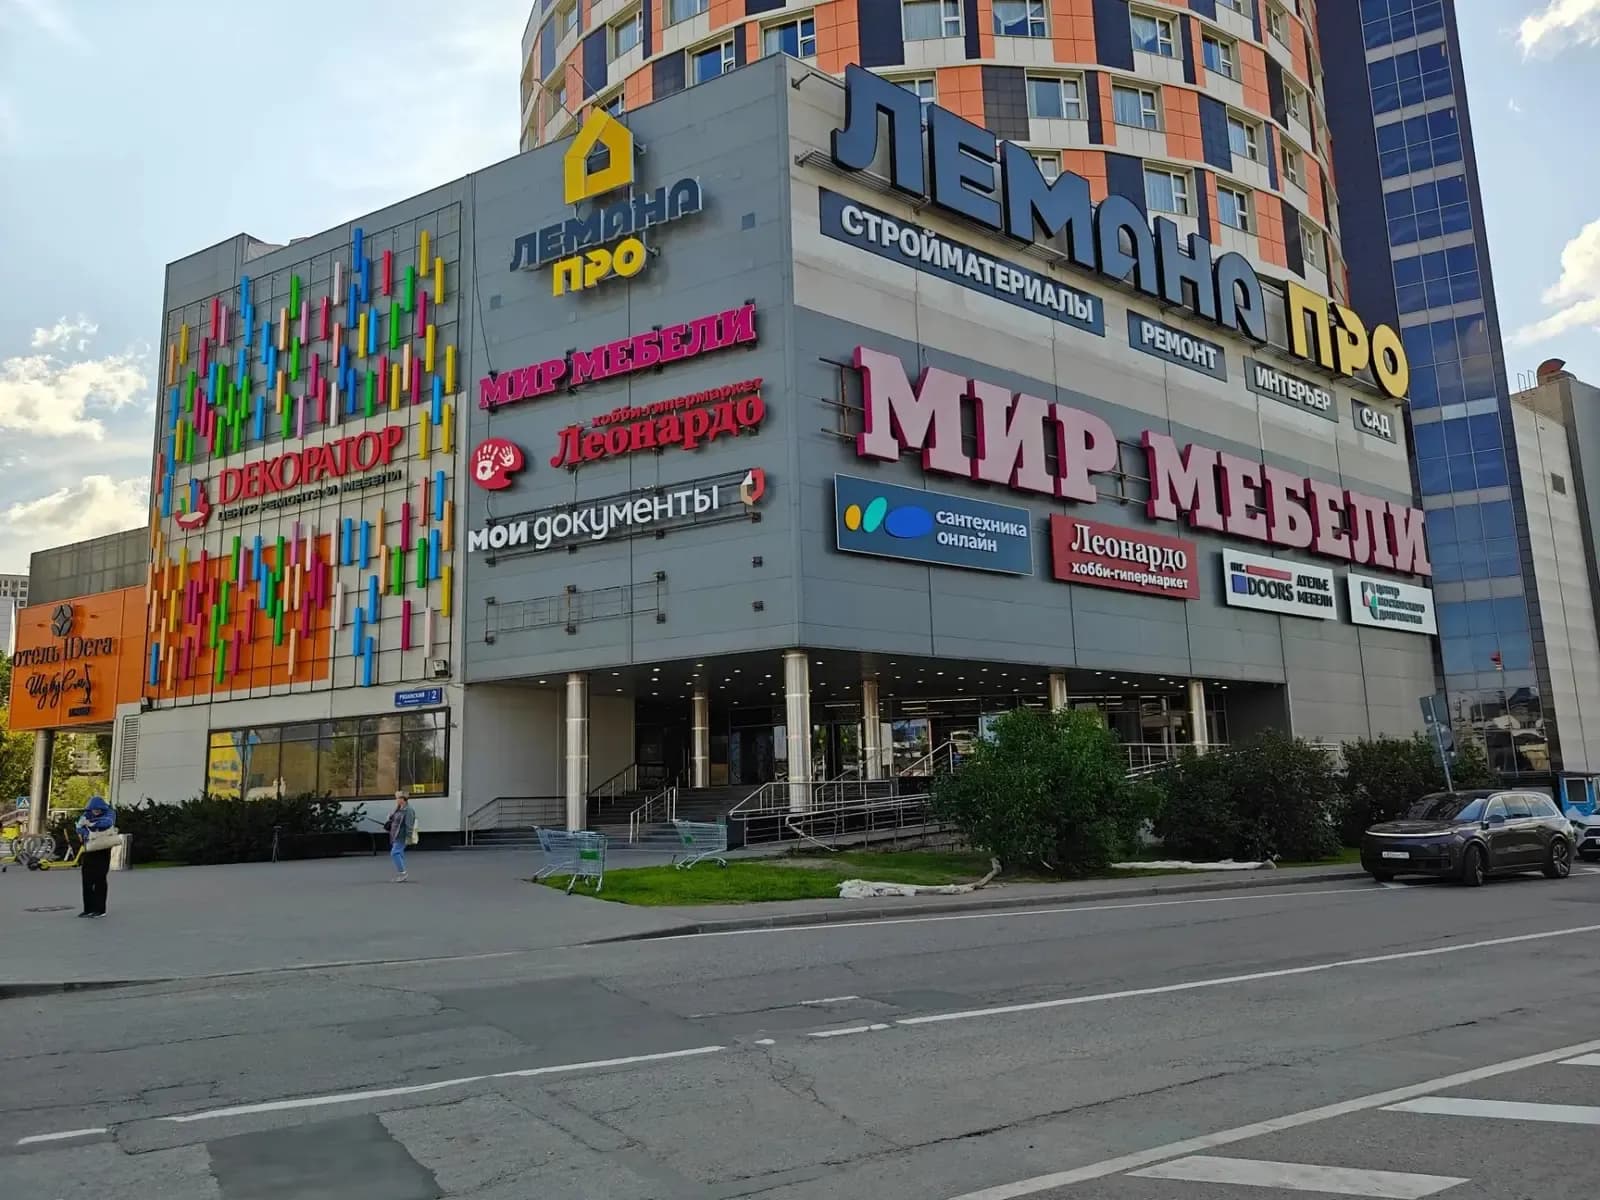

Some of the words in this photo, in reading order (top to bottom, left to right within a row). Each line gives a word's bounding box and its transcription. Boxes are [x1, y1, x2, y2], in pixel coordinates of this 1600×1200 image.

[510, 175, 703, 273] ЛЕМАНА
[830, 62, 1268, 343] ЛЕМАНА
[1285, 279, 1410, 399] ПРО
[553, 237, 647, 297] ПРО
[840, 204, 1095, 323] СТРОЙМАТЕРИАЛЫ
[479, 358, 567, 410] МИР
[570, 302, 757, 386] МЕБЕЛИ
[1140, 320, 1218, 370] РЕМОНТ
[591, 376, 764, 428] хобби-гипермаркет
[1254, 366, 1332, 411] ИНТЕРЬЕР
[550, 394, 765, 469] Леонардо
[1361, 406, 1391, 438] САД
[852, 345, 1118, 505] МИР
[1140, 429, 1433, 578] МЕБЕЛИ
[217, 503, 259, 522] ЦЕНТР
[261, 489, 325, 512] РЕМОНТА
[341, 469, 402, 492] МЕБЕЛИ
[533, 485, 719, 550] документы
[935, 510, 1028, 538] сантехника
[936, 531, 998, 552] онлайн
[1071, 523, 1187, 573] Леонардо
[1072, 561, 1189, 590] хобби-гипермаркет
[1247, 576, 1294, 602] DOORS
[1296, 574, 1330, 592] АТЕЛЬЕ
[1297, 590, 1334, 608] МЕБЕЛИ
[432, 690, 437, 700] 2
